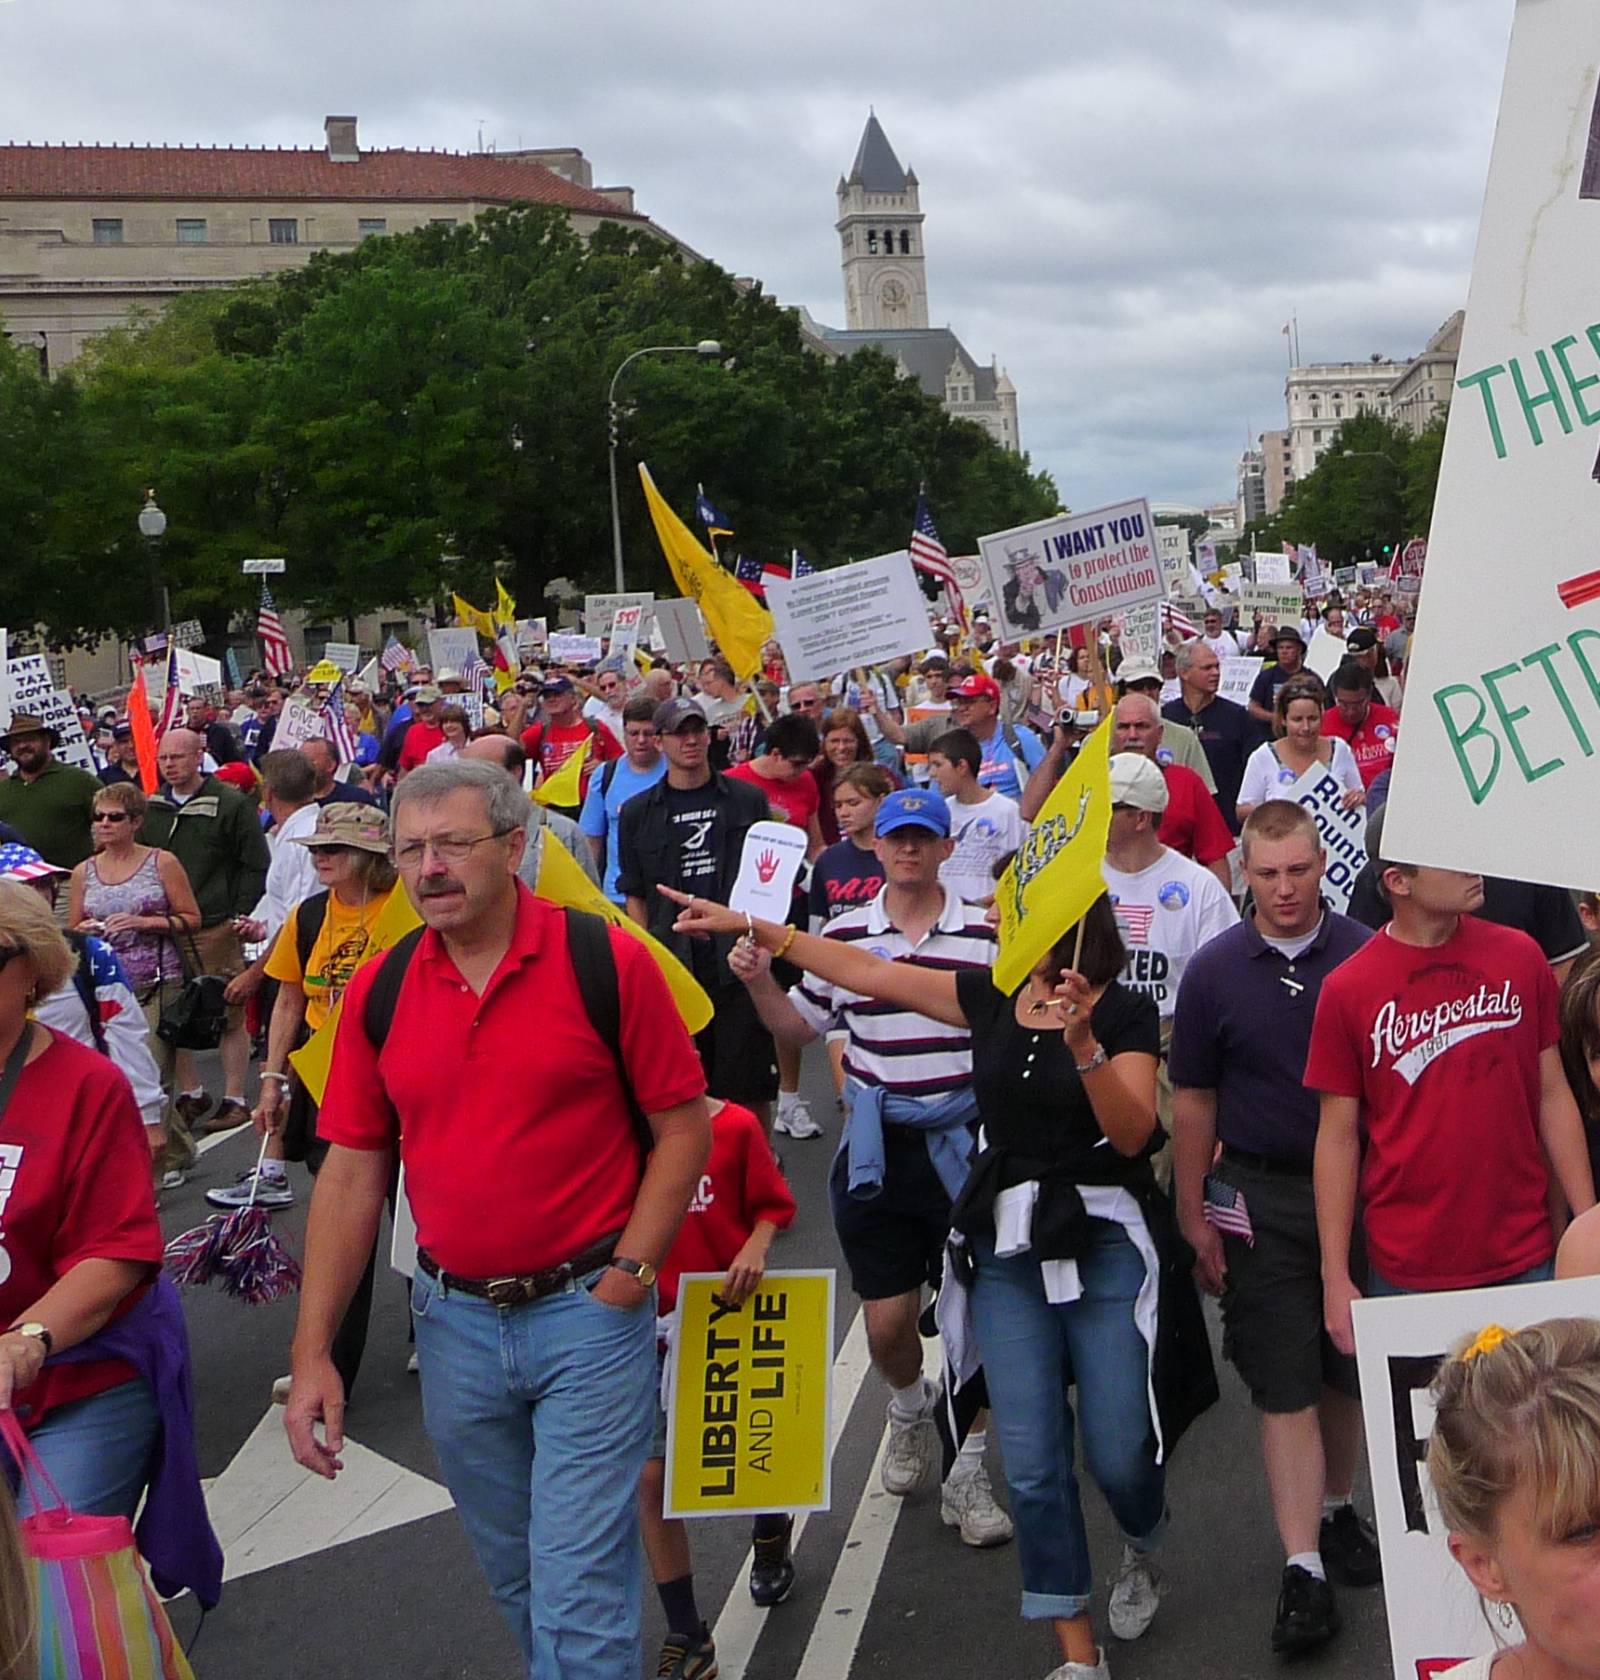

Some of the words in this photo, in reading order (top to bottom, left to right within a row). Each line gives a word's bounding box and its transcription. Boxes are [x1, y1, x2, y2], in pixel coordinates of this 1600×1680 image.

[1043, 539, 1052, 564] I
[1053, 523, 1107, 560] WANT
[1108, 513, 1145, 544] YOU
[1068, 563, 1083, 581] to
[1084, 551, 1127, 580] protect
[1128, 542, 1150, 562] the
[1070, 567, 1156, 607] Constitution
[7, 658, 41, 675] ANT
[16, 673, 48, 687] TAX
[15, 684, 53, 701] GOVT
[42, 705, 75, 721] ORK
[1125, 948, 1169, 982] TED
[1420, 1032, 1451, 1065] 1987
[750, 1292, 788, 1400] LIFE
[700, 1291, 744, 1497] LIBERTY
[747, 1408, 773, 1473] AND
